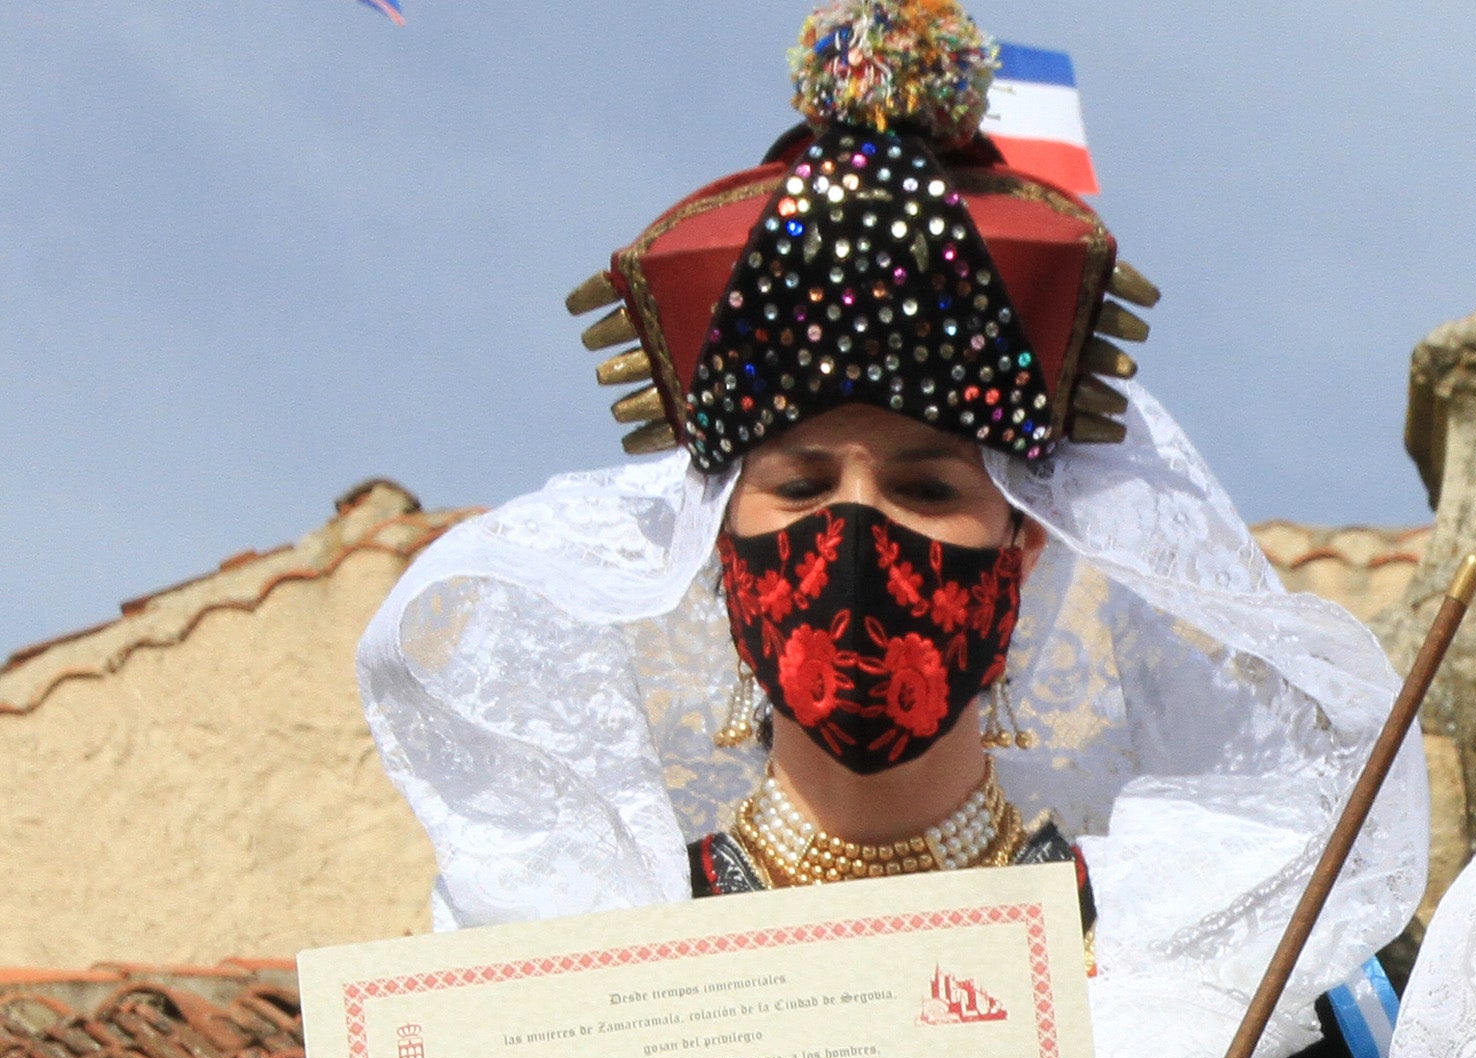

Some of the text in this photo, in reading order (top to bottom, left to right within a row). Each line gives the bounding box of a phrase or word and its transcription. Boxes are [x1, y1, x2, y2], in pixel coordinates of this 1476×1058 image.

[609, 975, 786, 1005] Desde tiempos inmemoriales
[504, 1035, 522, 1045] las
[527, 1029, 575, 1042] mujeres
[580, 1026, 592, 1035] de
[741, 1005, 753, 1015] de
[758, 1003, 769, 1012] la
[774, 997, 818, 1011] Ciudad
[823, 996, 835, 1005] de
[682, 1037, 699, 1049] del
[704, 1032, 762, 1048] privilegio
